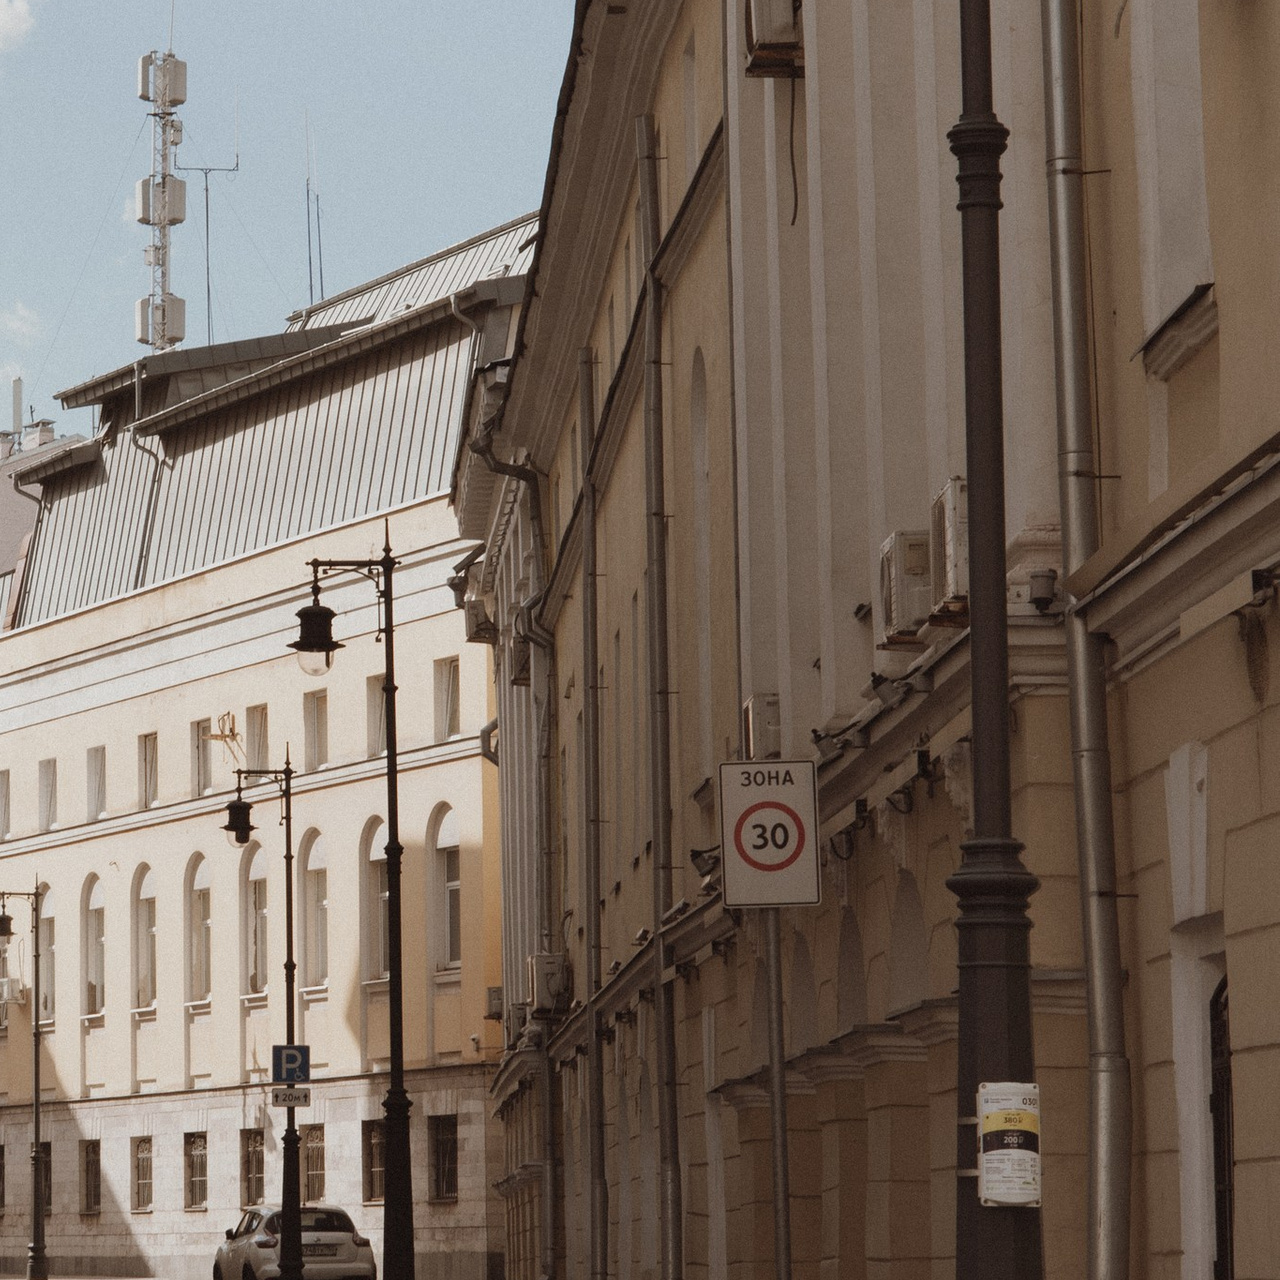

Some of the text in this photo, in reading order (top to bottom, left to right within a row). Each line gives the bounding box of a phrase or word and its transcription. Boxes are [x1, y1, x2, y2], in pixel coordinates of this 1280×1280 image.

[740, 769, 795, 787] ЗОНА
[751, 822, 789, 850] 30
[281, 1049, 302, 1079] P
